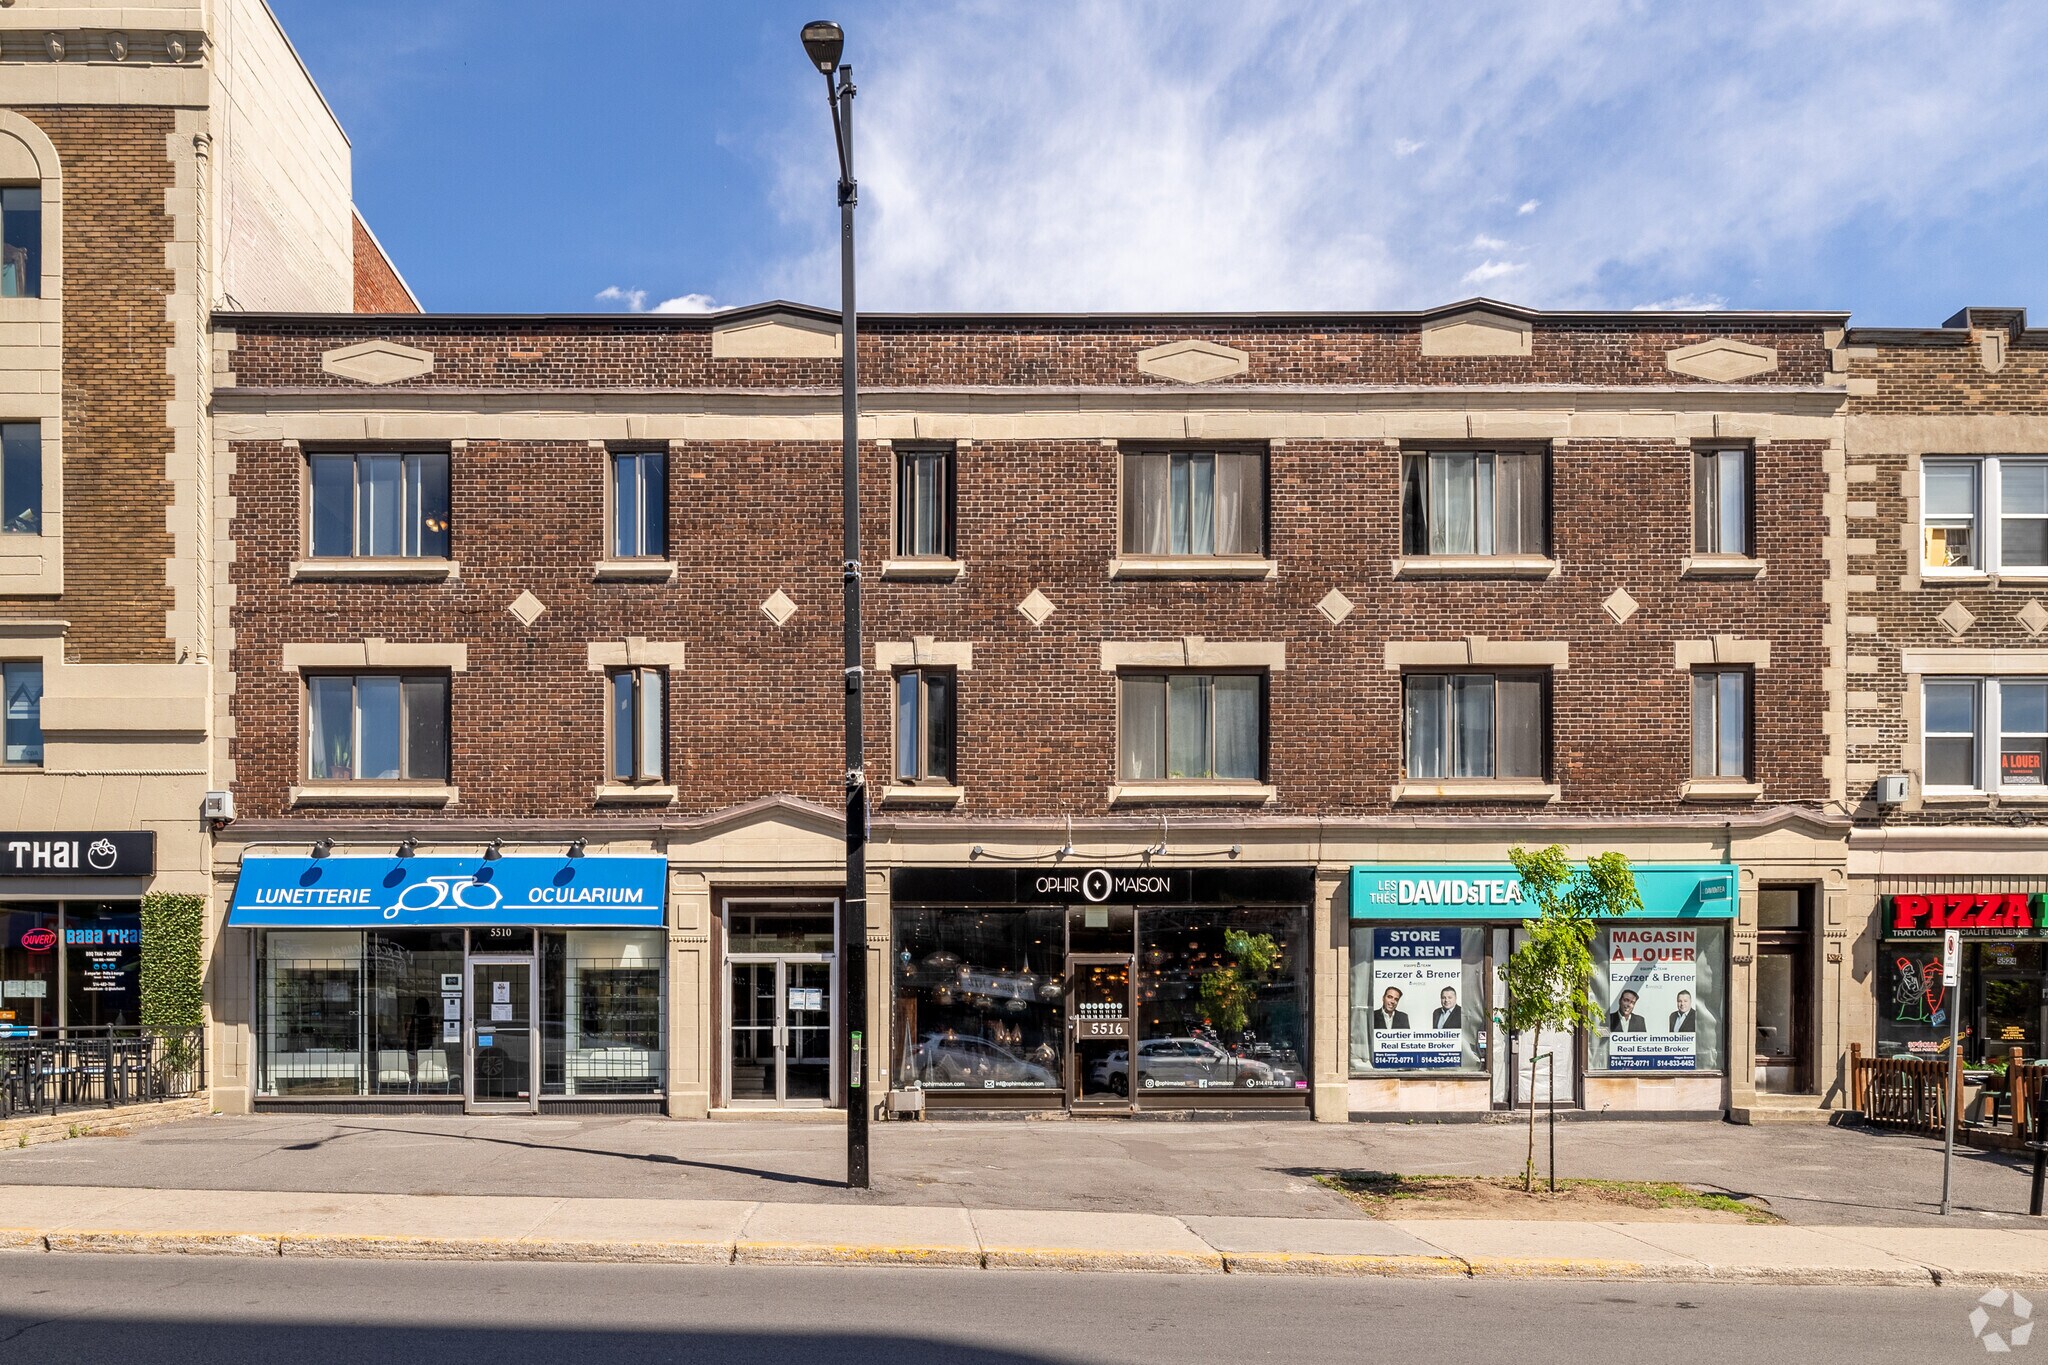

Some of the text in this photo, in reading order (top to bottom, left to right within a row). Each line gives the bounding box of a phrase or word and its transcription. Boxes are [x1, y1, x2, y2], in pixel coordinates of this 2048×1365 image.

[2010, 754, 2040, 768] LOUER
[1036, 877, 1080, 893] OPHIR
[1115, 877, 1171, 893] MAISON
[1378, 880, 1397, 891] LES
[255, 888, 371, 904] LUNETTERIE
[528, 887, 643, 904] OCULARIUM
[1398, 879, 1522, 905] DAVIDsTEA
[1369, 892, 1397, 904] THÉS
[1893, 894, 2033, 928] PIZZA
[490, 928, 512, 937] 5510
[1390, 931, 1440, 942] STORE
[1612, 931, 1695, 943] MAGASIN
[1892, 929, 1937, 937] TRATTORIA
[23, 934, 54, 945] OUVERT
[1380, 946, 1455, 957] FOR RENT
[1612, 945, 1695, 962] À LOUER
[1375, 969, 1460, 978] Ezerzer & Brener
[1611, 973, 1695, 982] Ezerzer & Brener
[1091, 1022, 1123, 1035] 5516
[1375, 1031, 1461, 1039] Courtier immobilier
[1611, 1034, 1694, 1042] Courtier immobilier
[1375, 1056, 1414, 1064] 514-772-0771
[922, 1080, 966, 1088] ophirmaison.com
